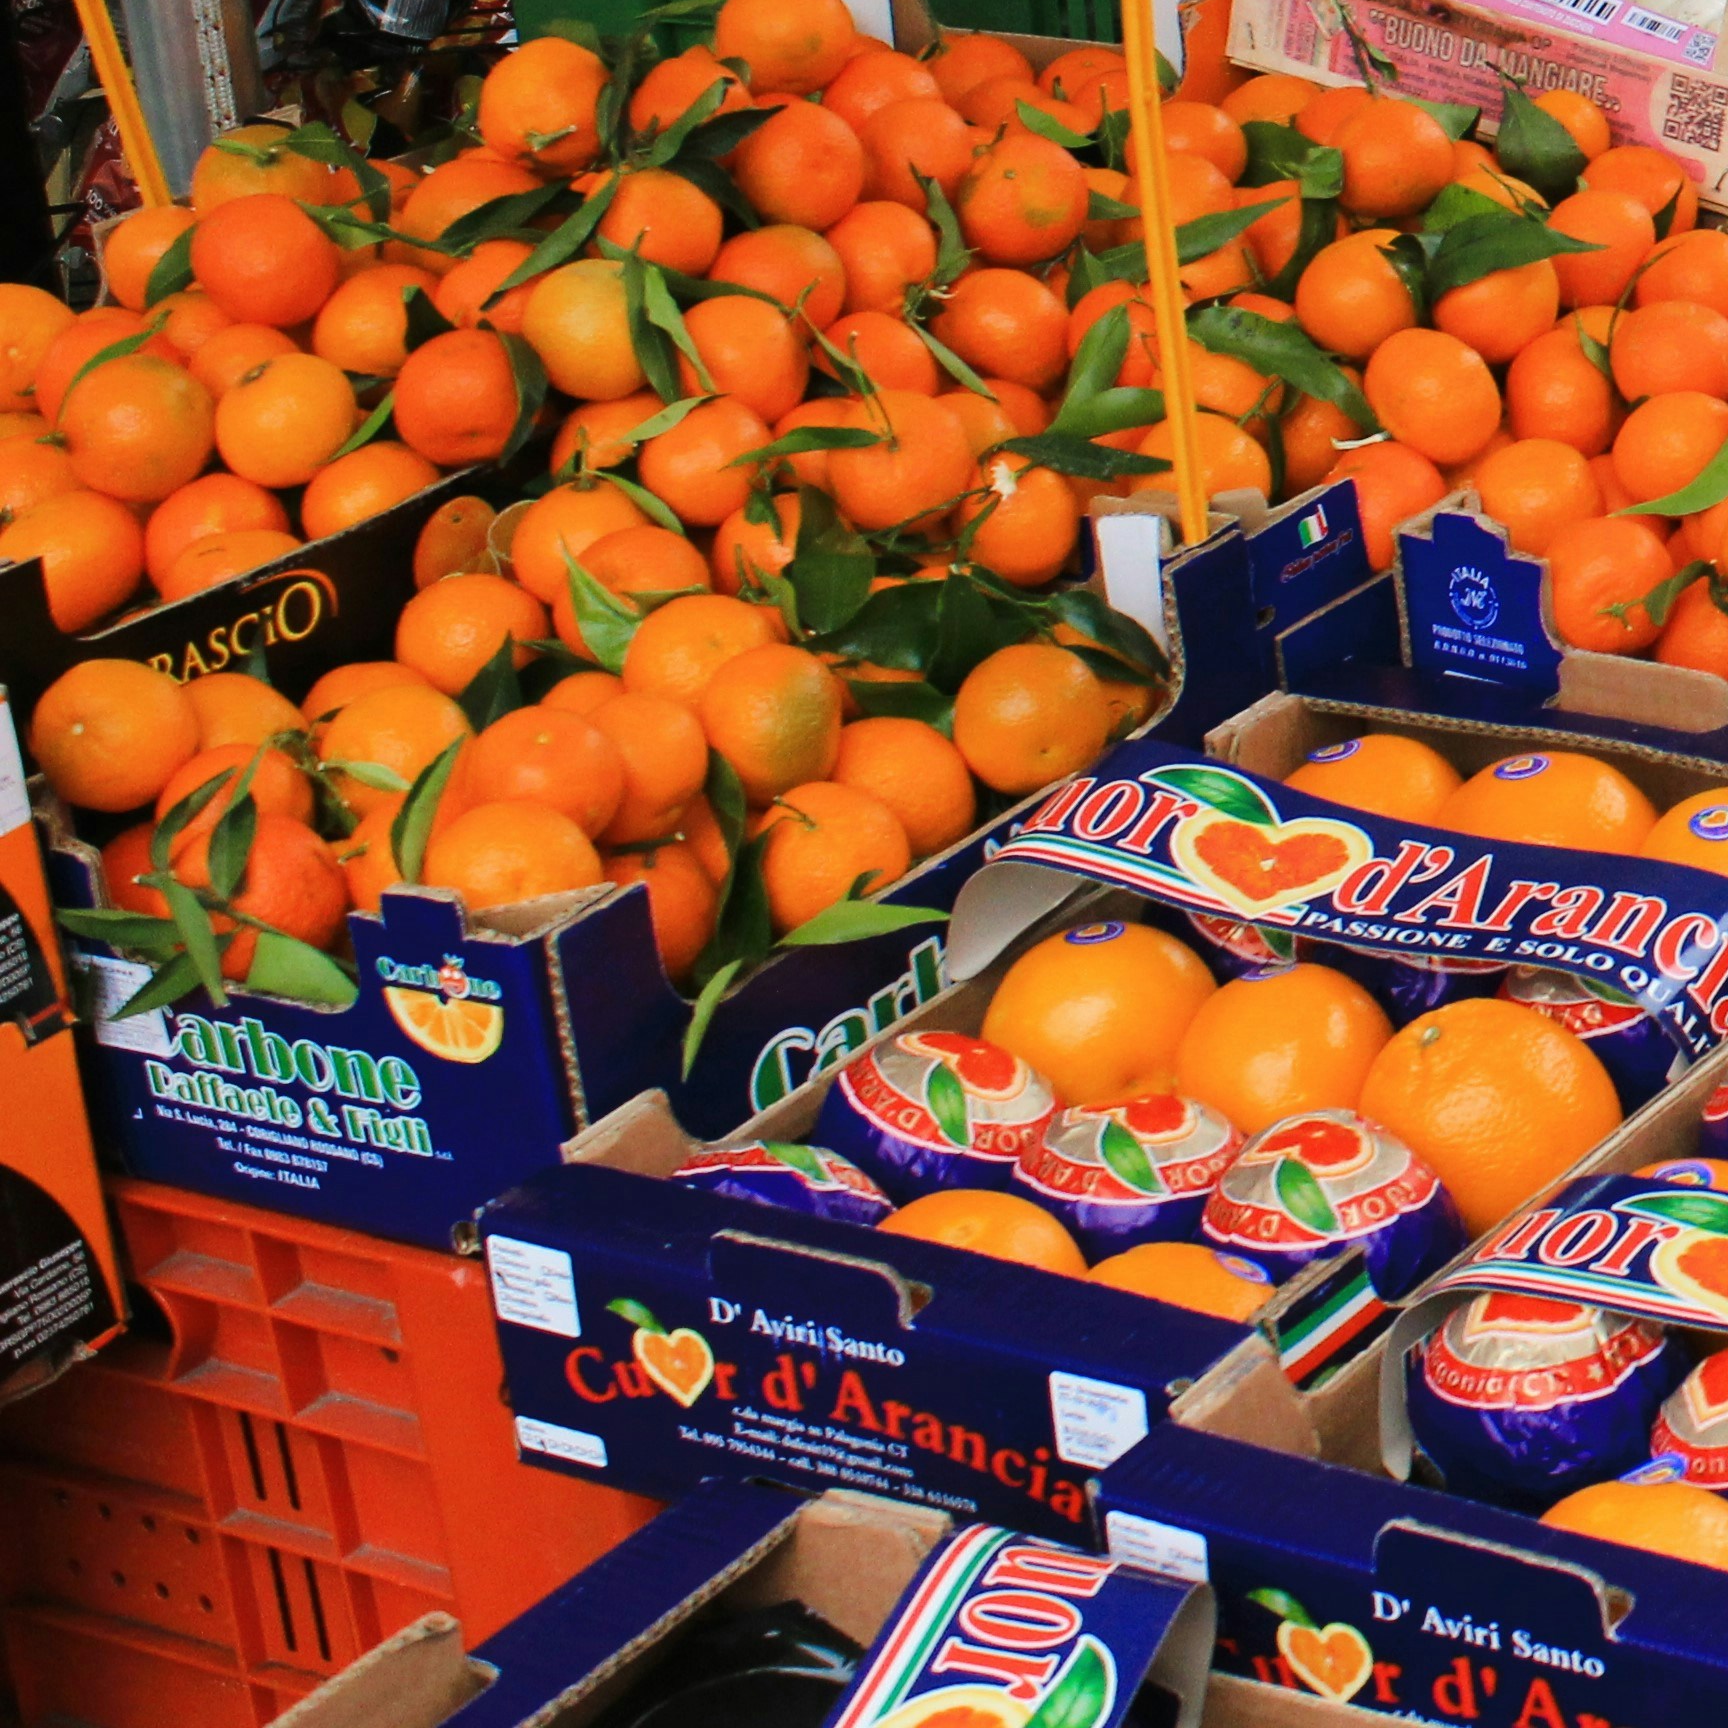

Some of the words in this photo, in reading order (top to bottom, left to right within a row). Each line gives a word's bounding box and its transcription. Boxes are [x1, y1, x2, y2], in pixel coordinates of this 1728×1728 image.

[1459, 38, 1493, 72] DA
[1451, 566, 1490, 590] ITALIA
[1300, 909, 1469, 952] PASSIONE
[1484, 934, 1508, 954] E
[1512, 937, 1618, 973] SOLO
[178, 1007, 422, 1111] arbone
[143, 1059, 303, 1129] Raffaele
[306, 1096, 344, 1140] &
[342, 1103, 435, 1158] Figli
[216, 1136, 237, 1152] Tel.
[242, 1141, 264, 1159] Fax
[231, 1160, 276, 1181] Origine:
[275, 1168, 321, 1190] ITALIA
[708, 1295, 742, 1325] D'
[748, 1305, 823, 1348] Aviri
[826, 1326, 907, 1368] Santo
[761, 1354, 817, 1413] d'
[829, 1369, 1087, 1523] Arancia
[1371, 1590, 1411, 1623] D'
[1420, 1606, 1502, 1651] Aviri
[1510, 1628, 1606, 1679] Santo
